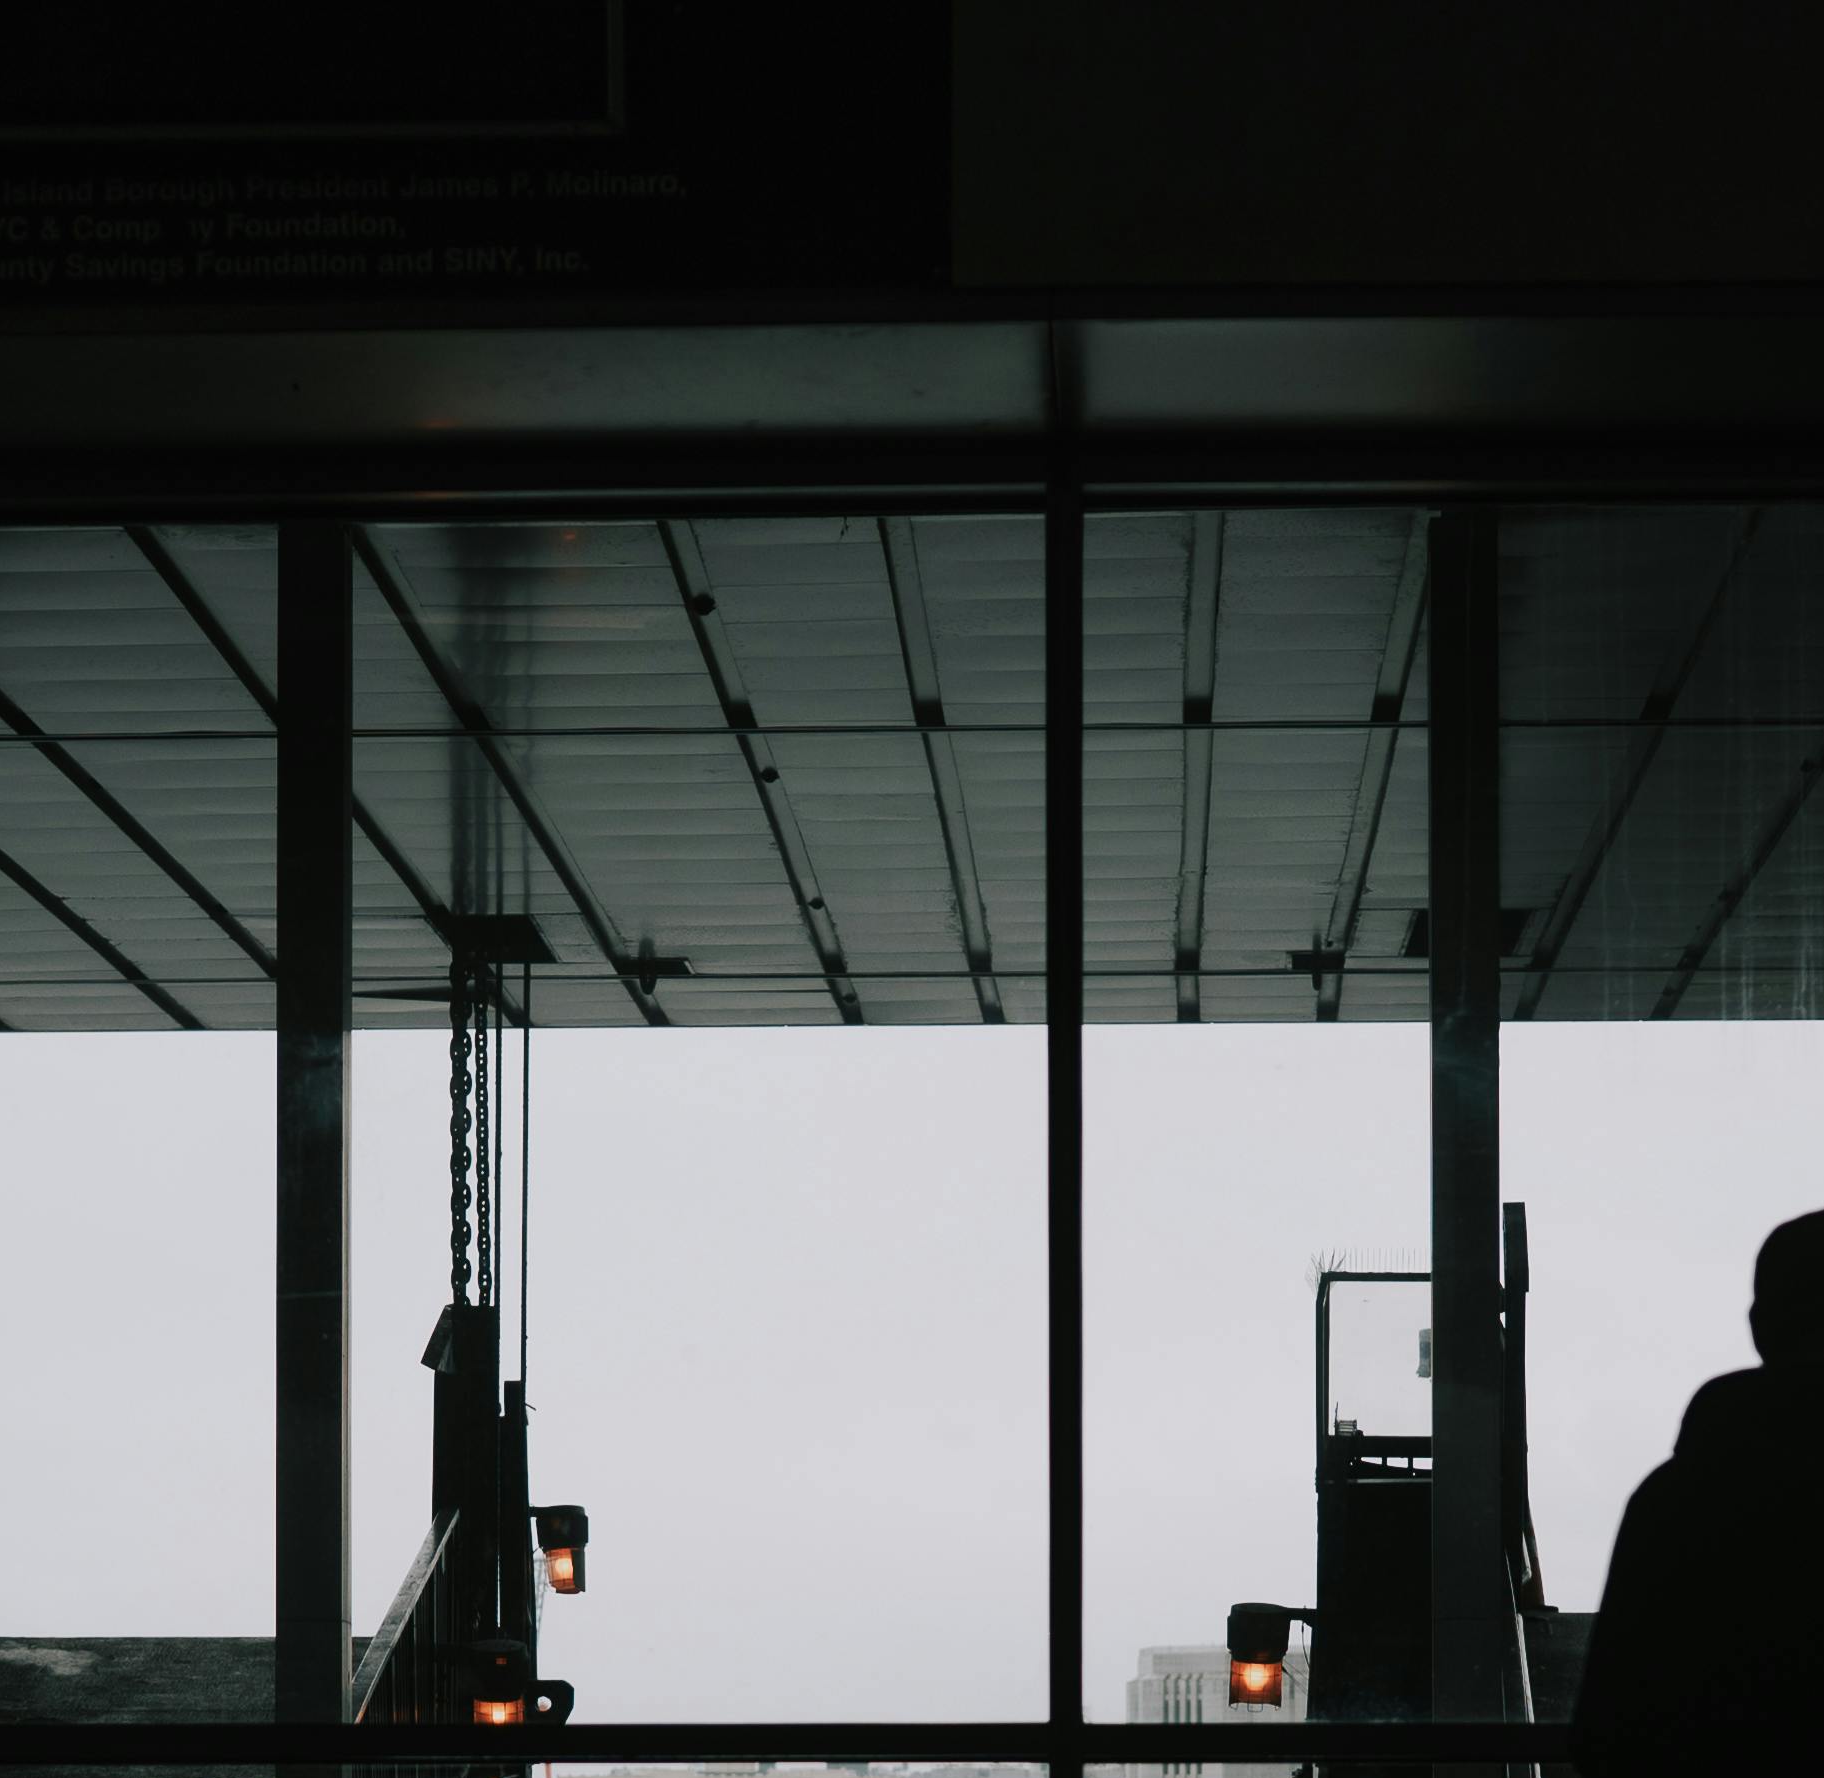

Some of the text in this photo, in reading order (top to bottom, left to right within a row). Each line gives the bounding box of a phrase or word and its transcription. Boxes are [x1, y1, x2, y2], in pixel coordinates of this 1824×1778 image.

[3, 177, 94, 205] Island
[105, 176, 235, 209] Borough
[246, 173, 389, 201] President
[399, 173, 498, 199] James
[511, 171, 536, 199] P.
[544, 168, 688, 198] Molinaro,
[40, 216, 63, 241] &
[72, 214, 215, 245] Compy
[225, 211, 406, 241] Foundation,
[65, 252, 185, 285] Savings
[196, 249, 368, 279] Foundation
[378, 248, 434, 277] and
[444, 245, 525, 277] SINY,
[535, 243, 590, 273] Inc.
